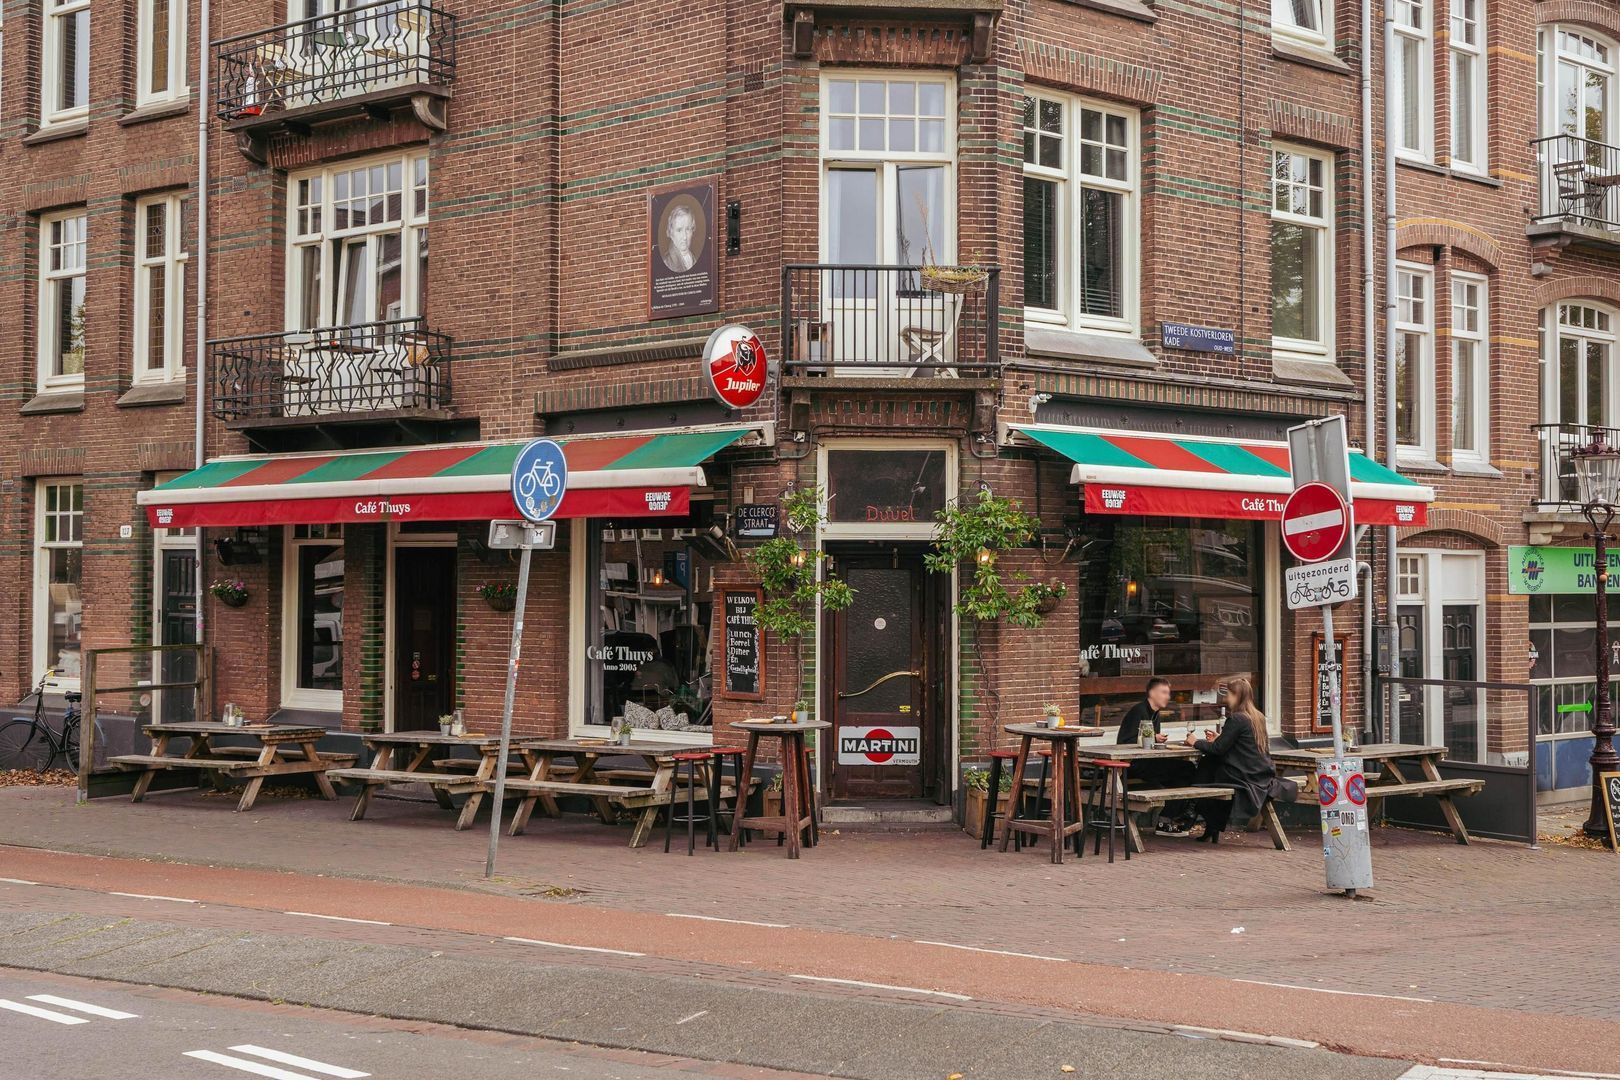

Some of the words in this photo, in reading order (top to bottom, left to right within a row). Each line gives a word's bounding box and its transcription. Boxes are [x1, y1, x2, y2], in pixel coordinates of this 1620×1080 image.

[1164, 325, 1189, 337] TWEEDE
[1190, 329, 1234, 342] KOSTVERLOREN
[1164, 336, 1180, 346] KADE
[723, 377, 761, 393] Jupiler
[355, 500, 377, 514] Café
[378, 501, 411, 516] Thuys
[1241, 497, 1265, 512] Café
[738, 507, 748, 518] DE
[749, 506, 776, 518] CLERCQ
[866, 505, 916, 521] Duvel
[743, 518, 769, 529] STRAAT
[1573, 553, 1620, 567] UITLTEN
[1288, 563, 1349, 581] uitgezonderd
[1577, 573, 1620, 588] BANEN
[726, 596, 756, 604] WELKOM
[730, 638, 750, 647] Borrel
[587, 645, 613, 660] Café
[615, 646, 653, 665] Thuys
[730, 647, 750, 656] Diner
[1102, 644, 1141, 662] Thuys
[603, 663, 618, 671] Anno
[844, 740, 915, 752] MARTINI
